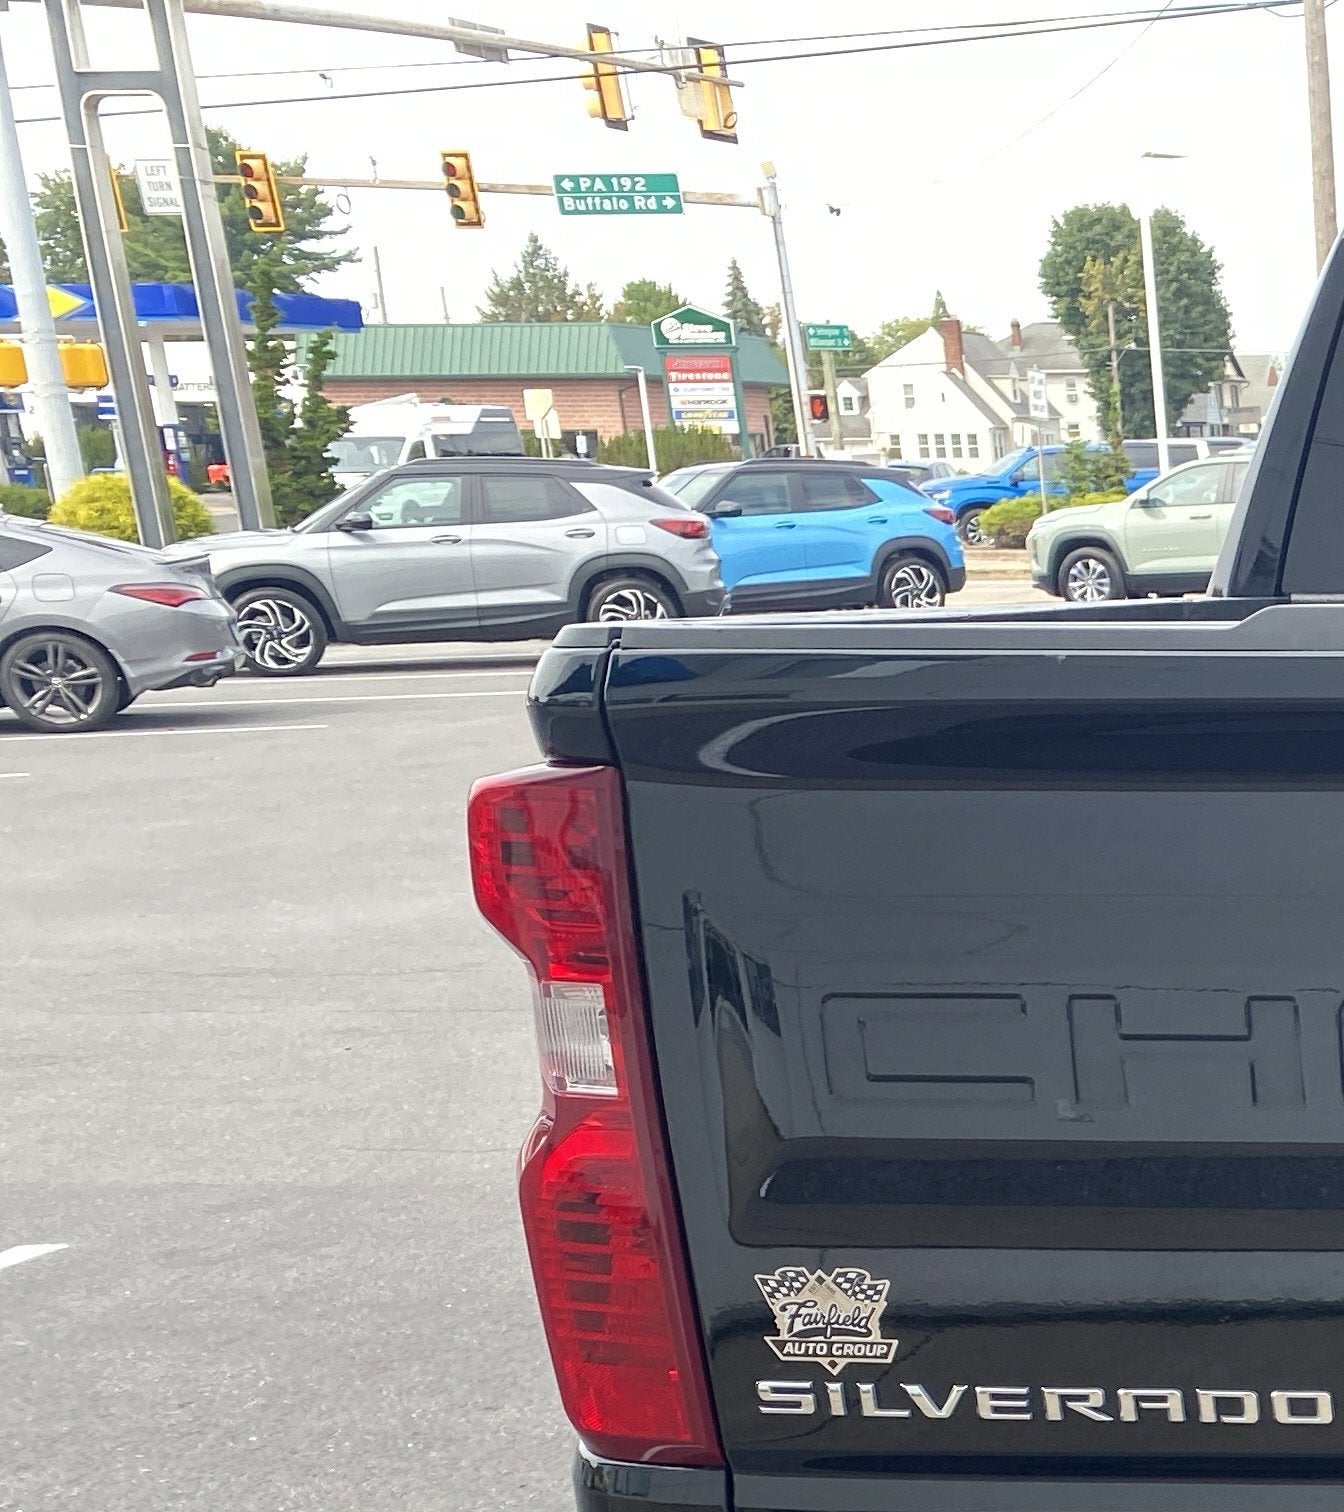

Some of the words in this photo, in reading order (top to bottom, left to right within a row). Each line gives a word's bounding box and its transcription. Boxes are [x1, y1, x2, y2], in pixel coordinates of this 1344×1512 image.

[145, 165, 167, 177] LEFT
[147, 181, 173, 191] TURN
[578, 177, 607, 192] PA
[610, 176, 647, 192] 192
[147, 196, 181, 208] SIGNAL
[562, 195, 630, 211] Buffalo
[633, 195, 658, 211] Rd
[668, 371, 730, 382] Firestone
[778, 1299, 877, 1340] Fairfield
[783, 1341, 829, 1356] AUTO
[831, 1342, 889, 1357] GROUP
[756, 1379, 1336, 1426] SILVERADO
